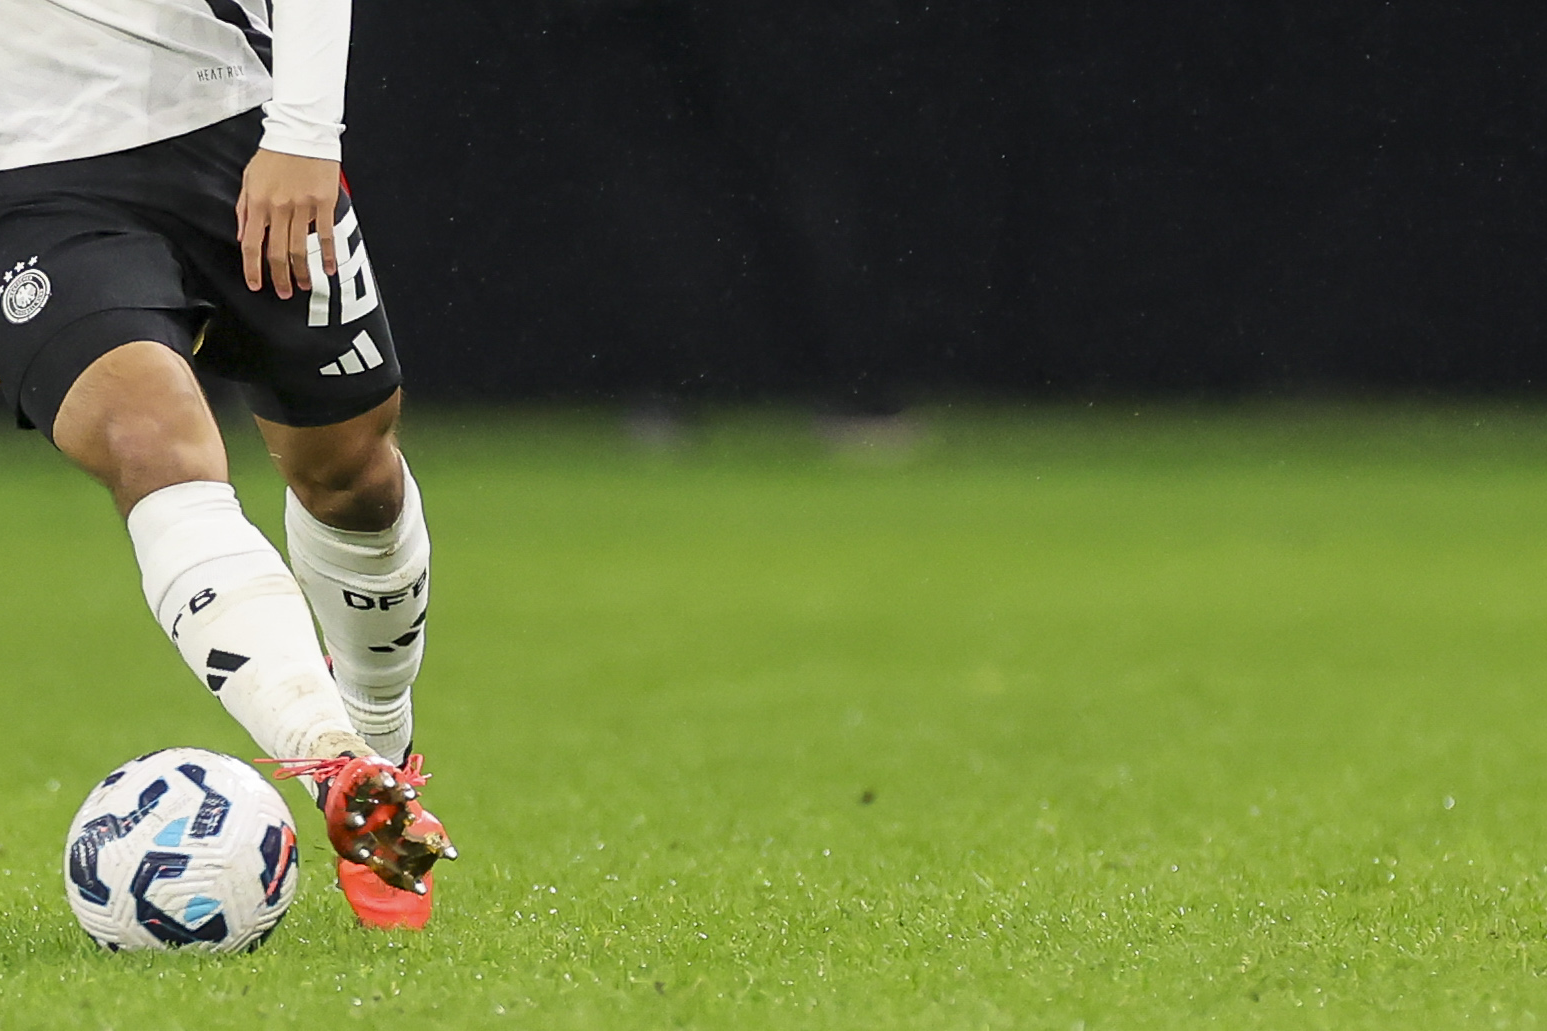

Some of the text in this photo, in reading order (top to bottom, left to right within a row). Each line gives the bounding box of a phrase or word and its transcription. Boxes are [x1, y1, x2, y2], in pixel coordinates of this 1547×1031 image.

[196, 67, 223, 82] HEAT
[307, 205, 380, 327] 16
[341, 566, 428, 611] DFB
